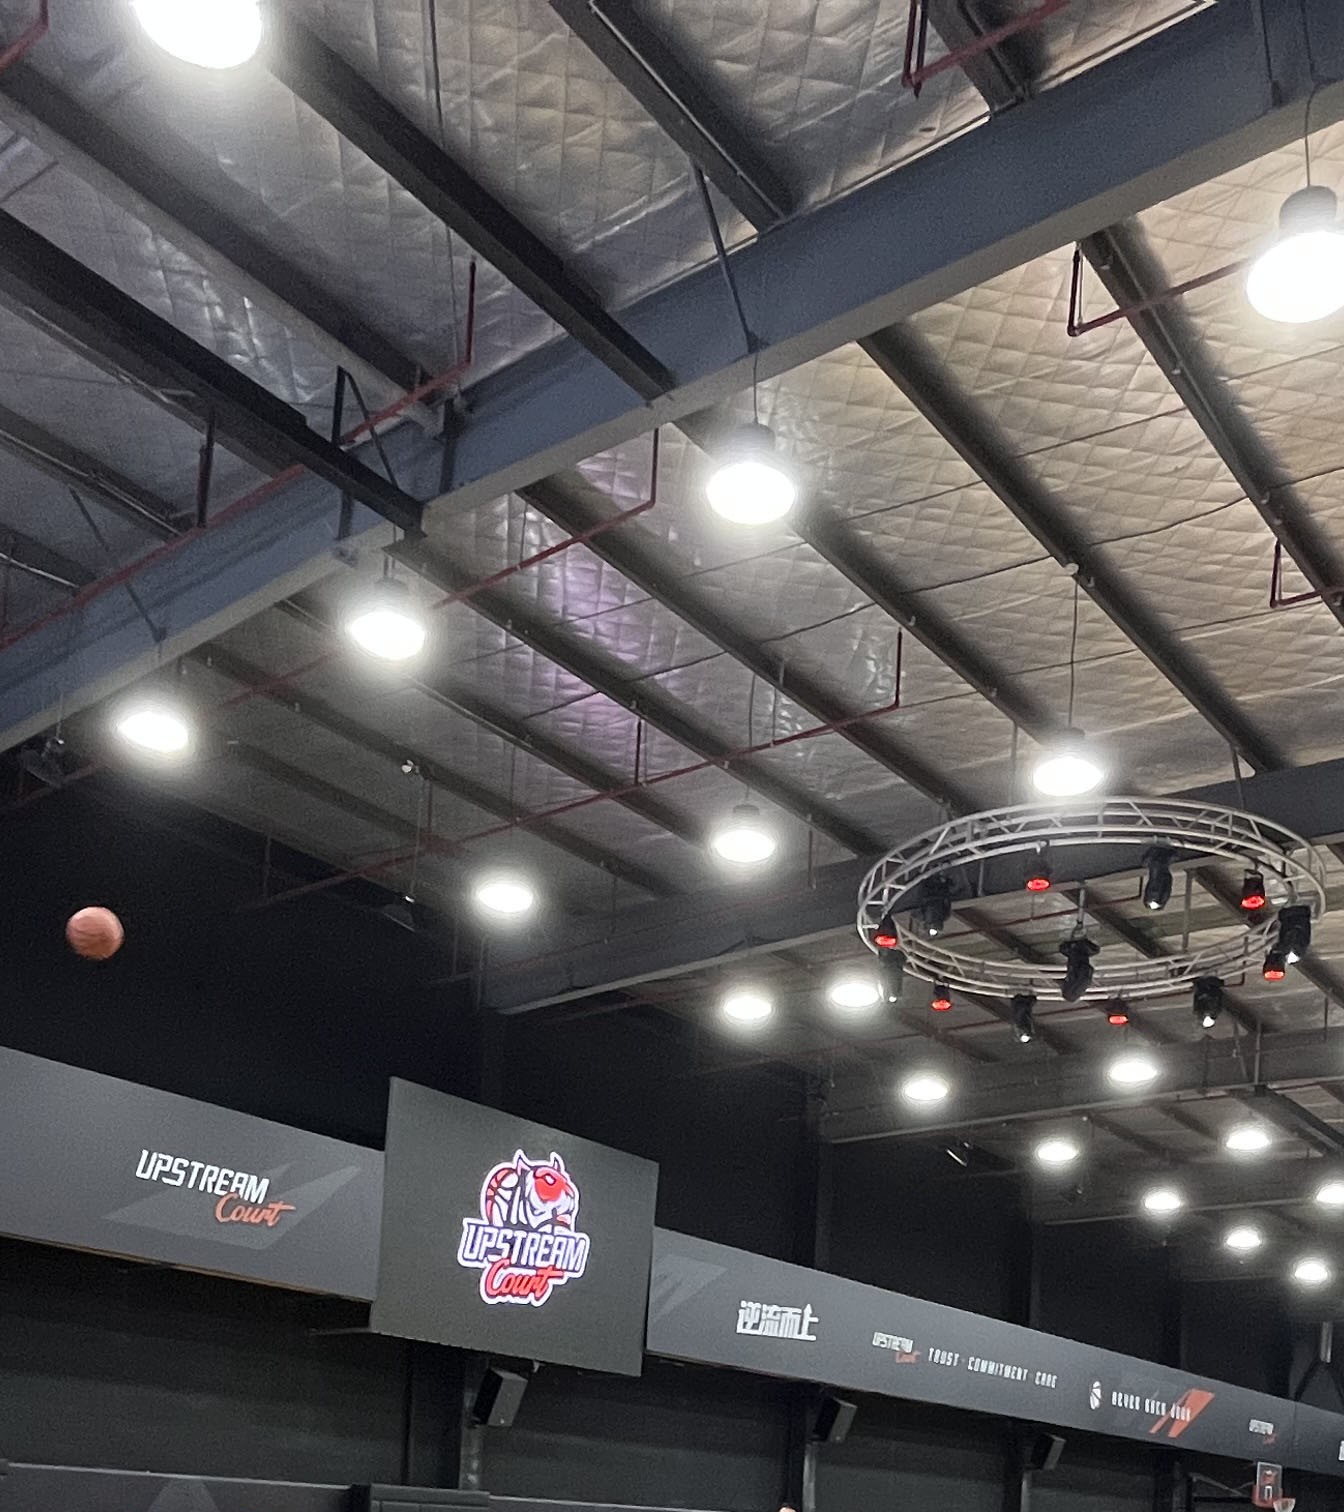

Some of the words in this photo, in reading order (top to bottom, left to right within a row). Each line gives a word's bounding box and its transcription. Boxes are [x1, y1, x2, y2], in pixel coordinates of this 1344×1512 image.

[136, 1150, 270, 1204] UPSTREAM
[215, 1192, 297, 1227] Court
[463, 1223, 586, 1272] UPSTREAM
[485, 1257, 565, 1300] Court
[736, 1300, 820, 1342] 逆流而上
[928, 1347, 960, 1367] TRUST
